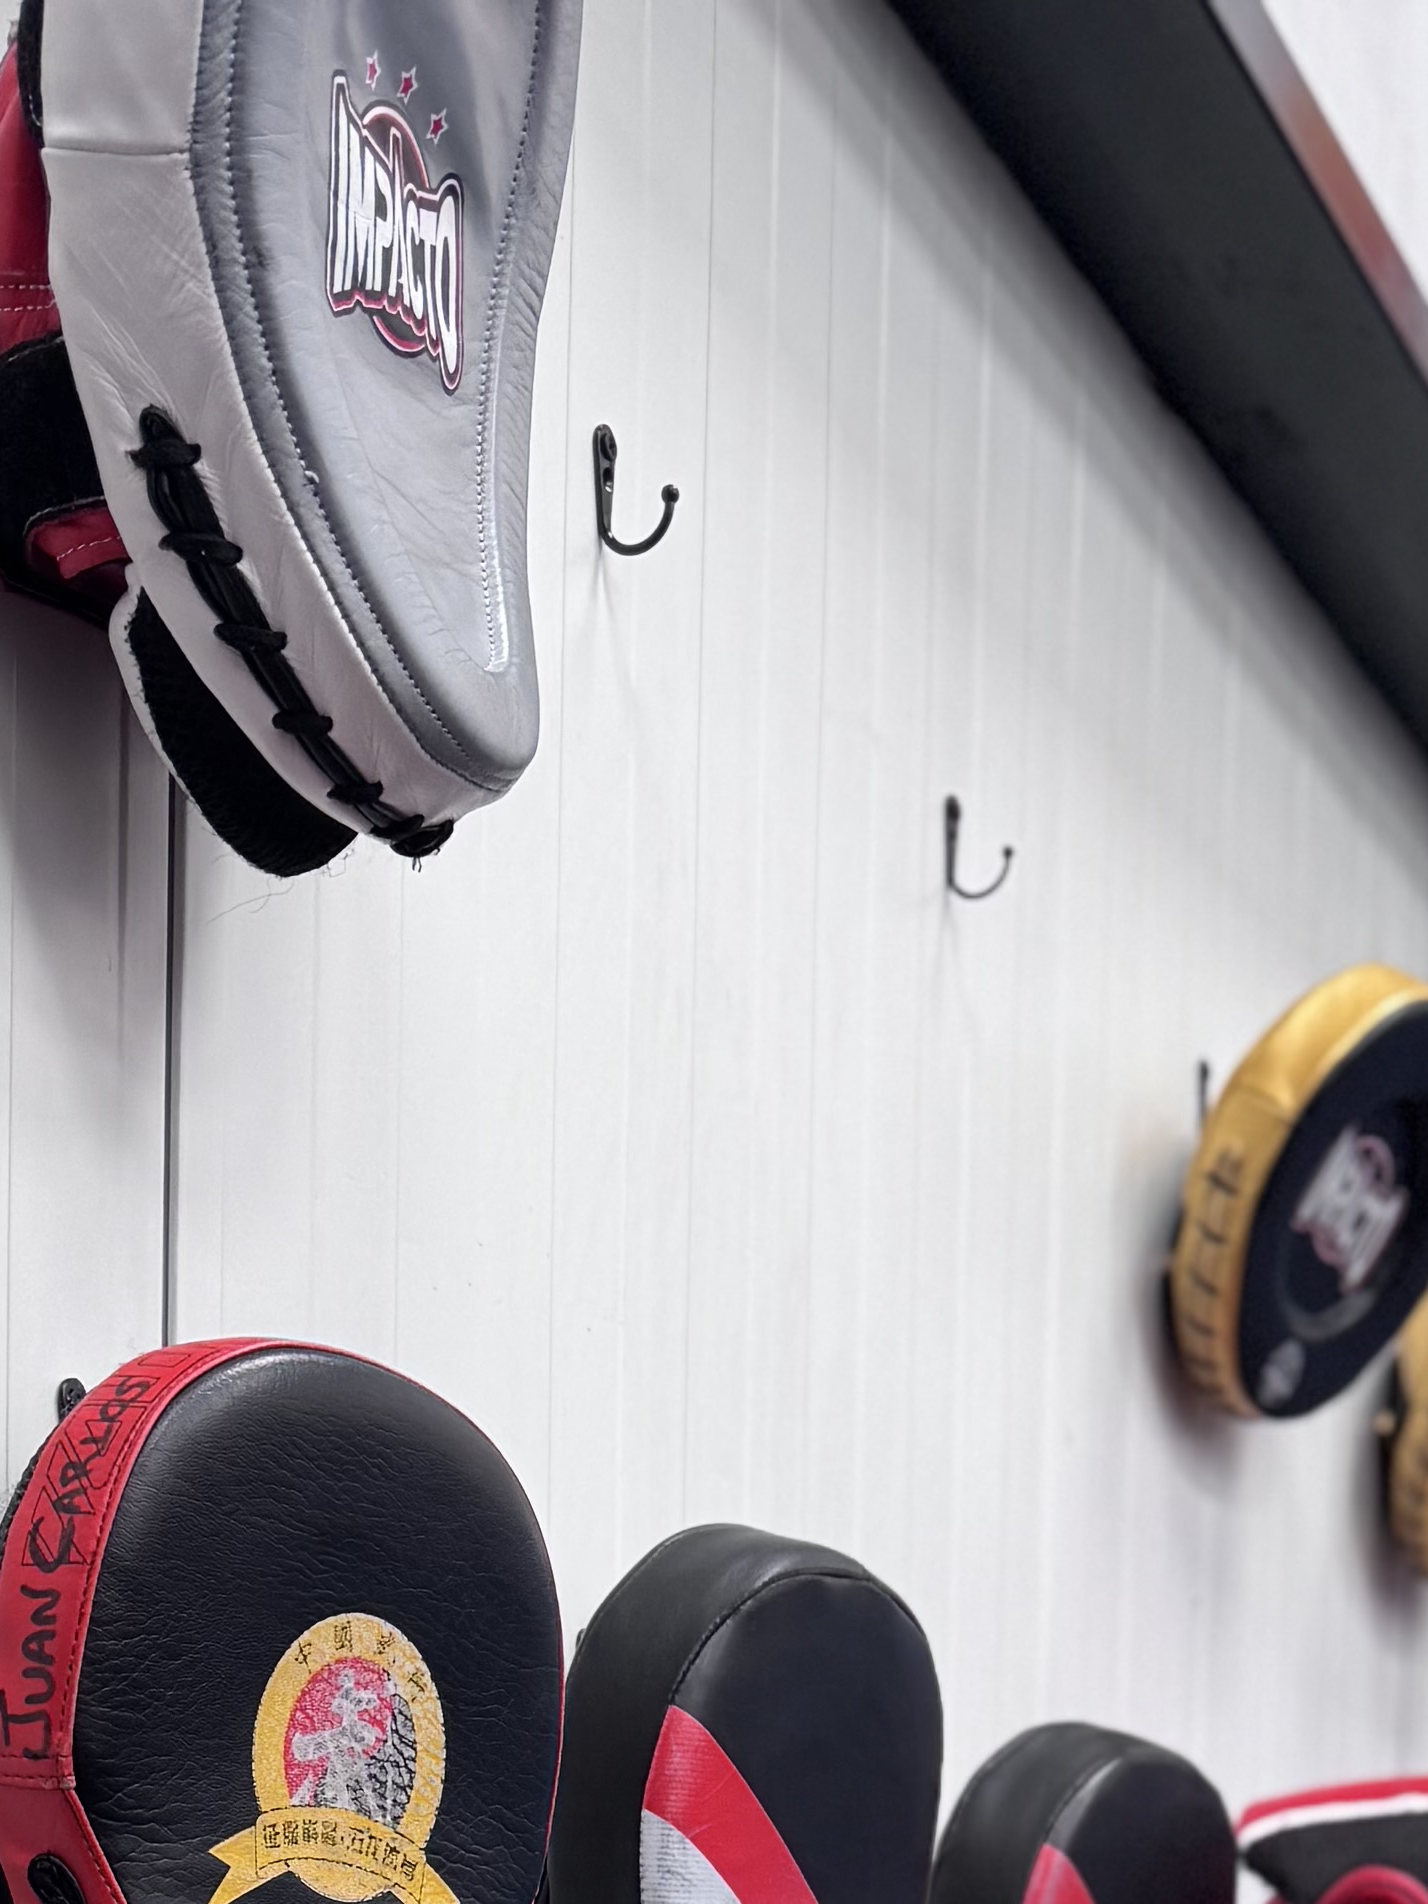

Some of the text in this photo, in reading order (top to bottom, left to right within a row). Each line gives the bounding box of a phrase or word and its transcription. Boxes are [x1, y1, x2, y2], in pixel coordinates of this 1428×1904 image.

[329, 74, 462, 391] IMPACTO
[0, 1375, 151, 1762] JUAN CARLOS
